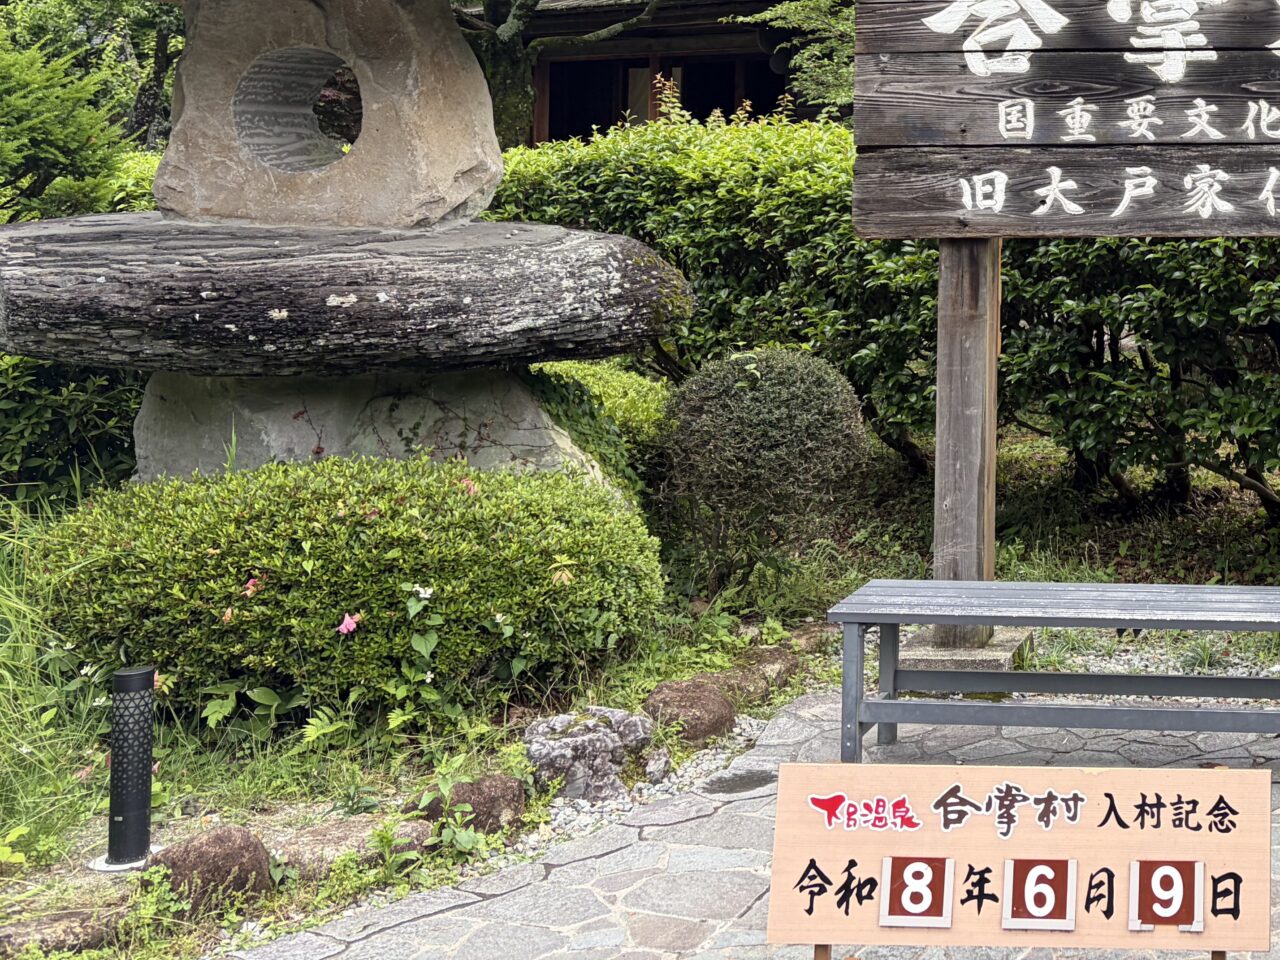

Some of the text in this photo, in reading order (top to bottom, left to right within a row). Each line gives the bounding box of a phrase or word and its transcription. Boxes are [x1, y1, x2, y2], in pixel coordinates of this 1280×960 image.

[811, 784, 1240, 836] 下呂温泉 合掌村 入村記念
[794, 859, 1243, 920] 令和8年6月9日
